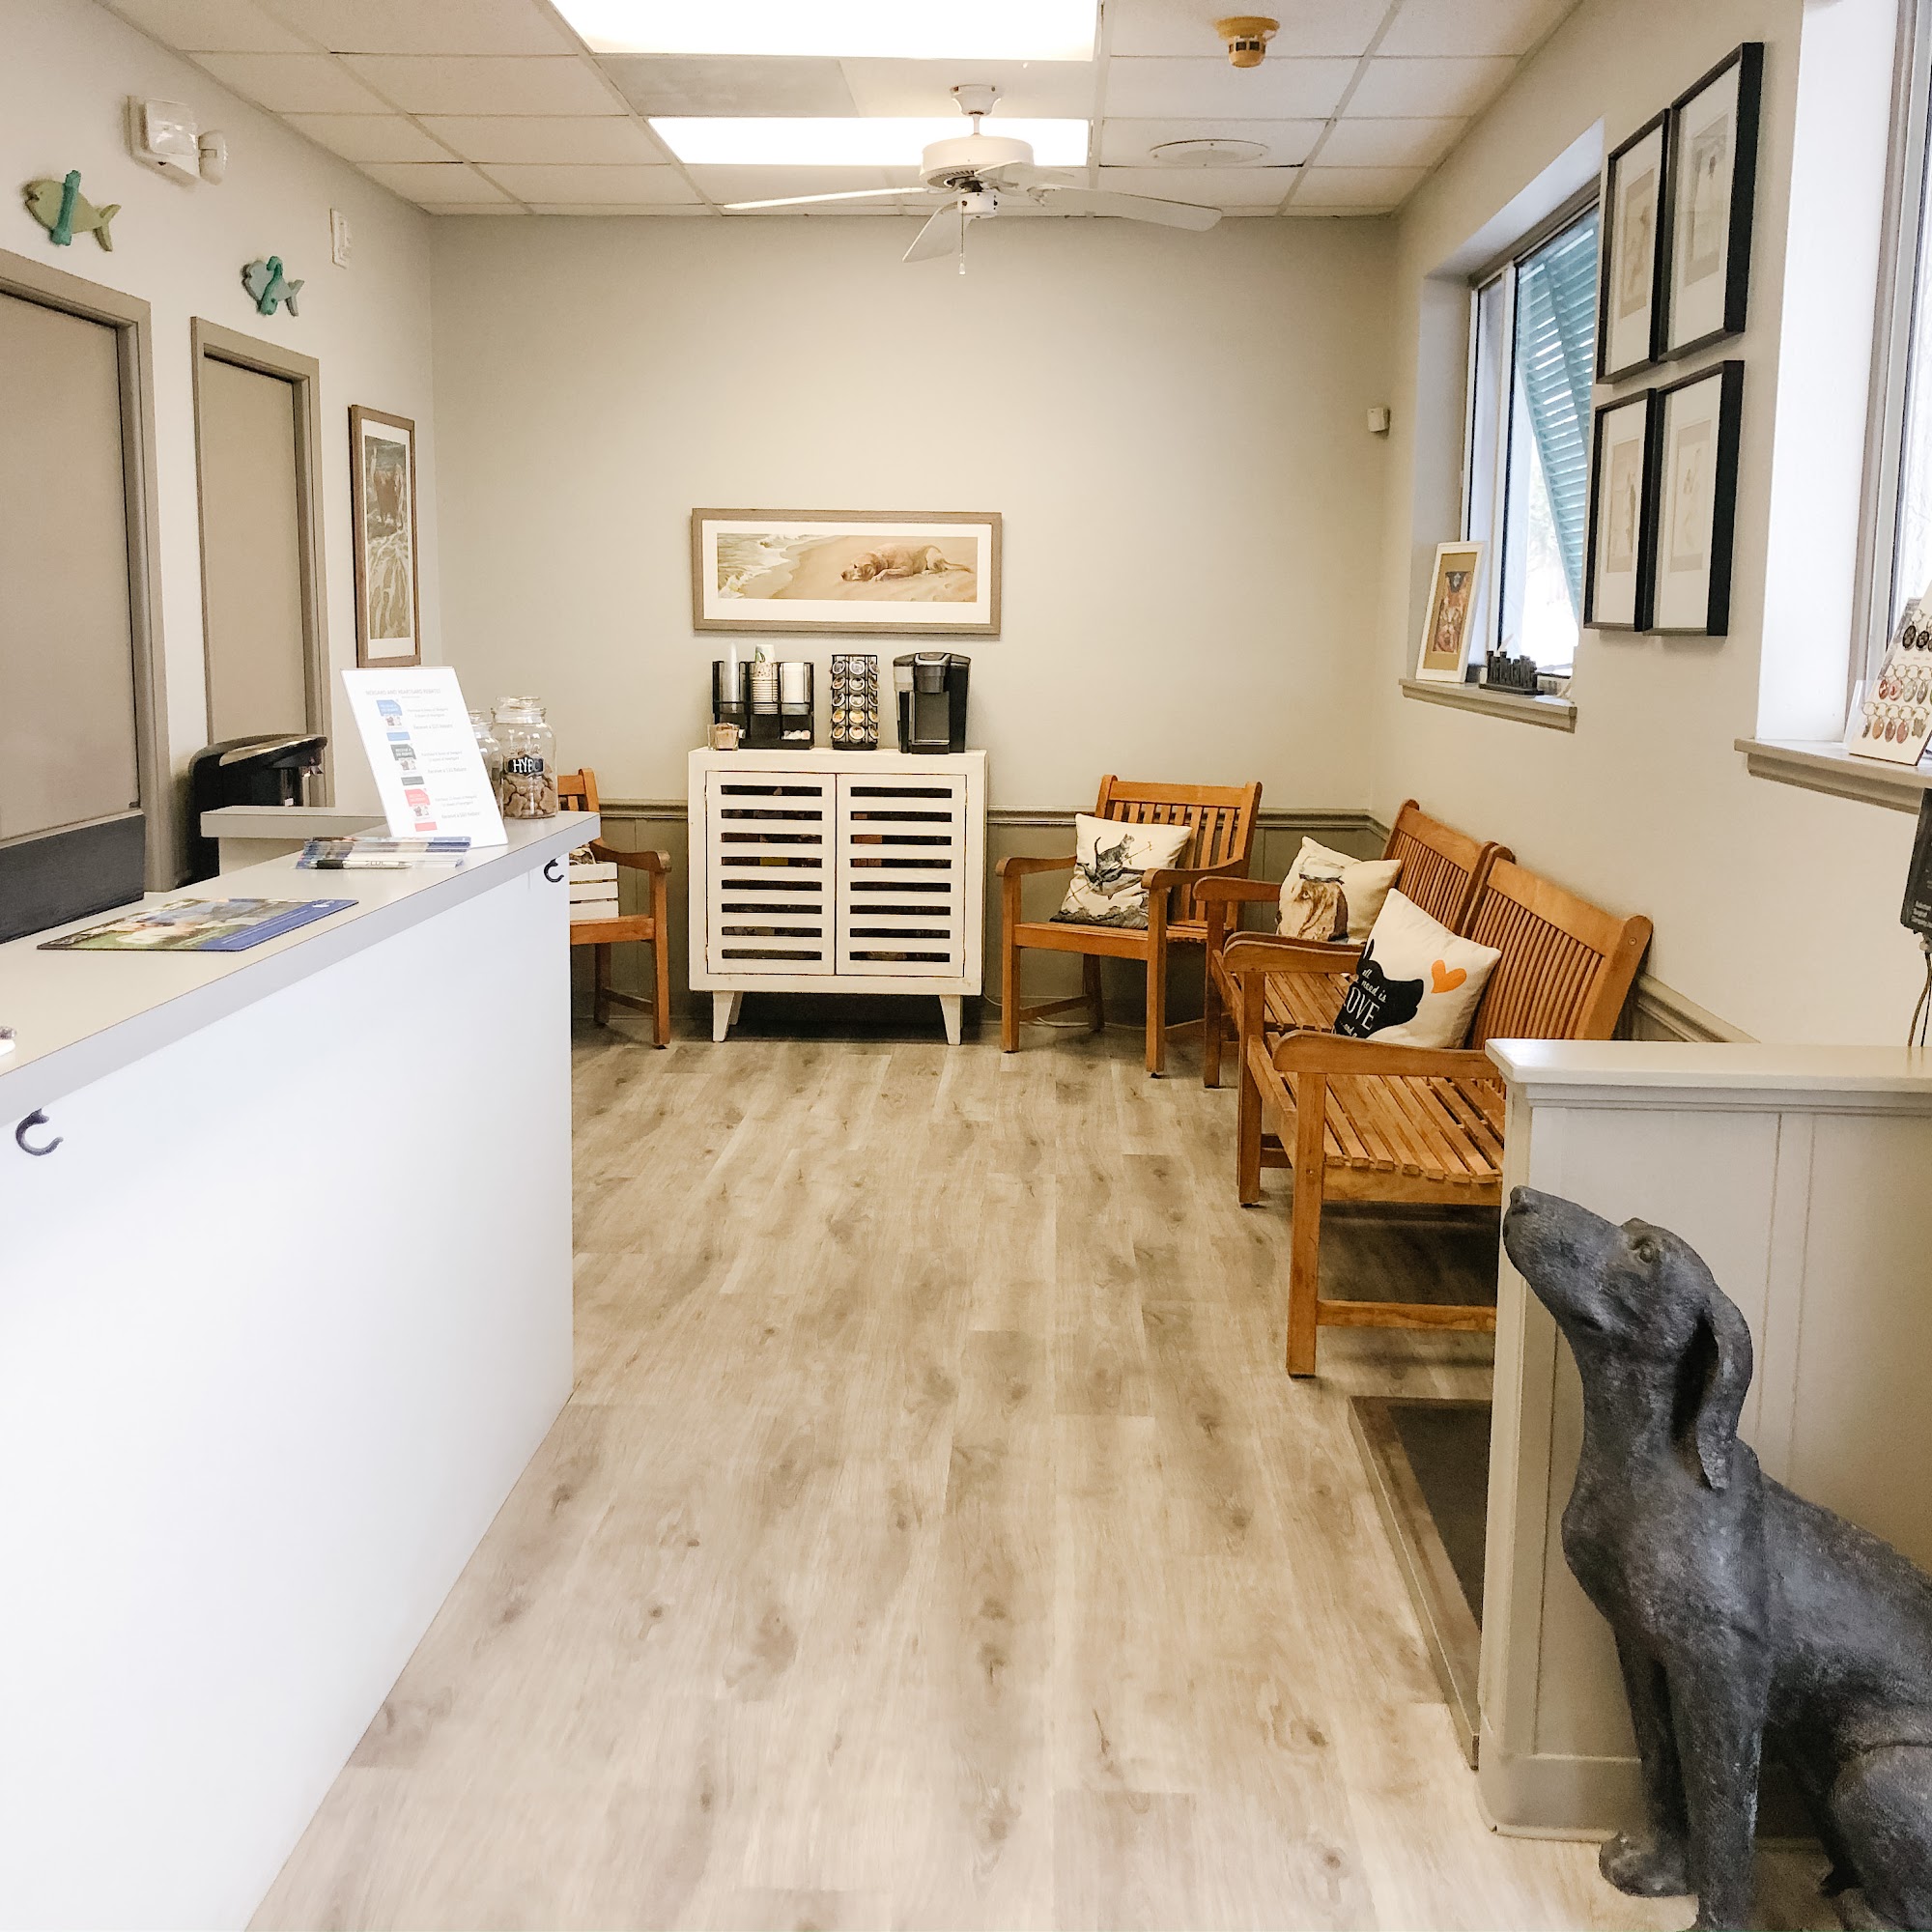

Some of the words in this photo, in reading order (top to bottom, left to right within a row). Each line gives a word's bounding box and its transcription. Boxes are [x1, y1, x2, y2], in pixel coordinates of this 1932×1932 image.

[1344, 986, 1380, 1031] OVE
[1361, 980, 1380, 996] need
[1378, 989, 1387, 1003] is
